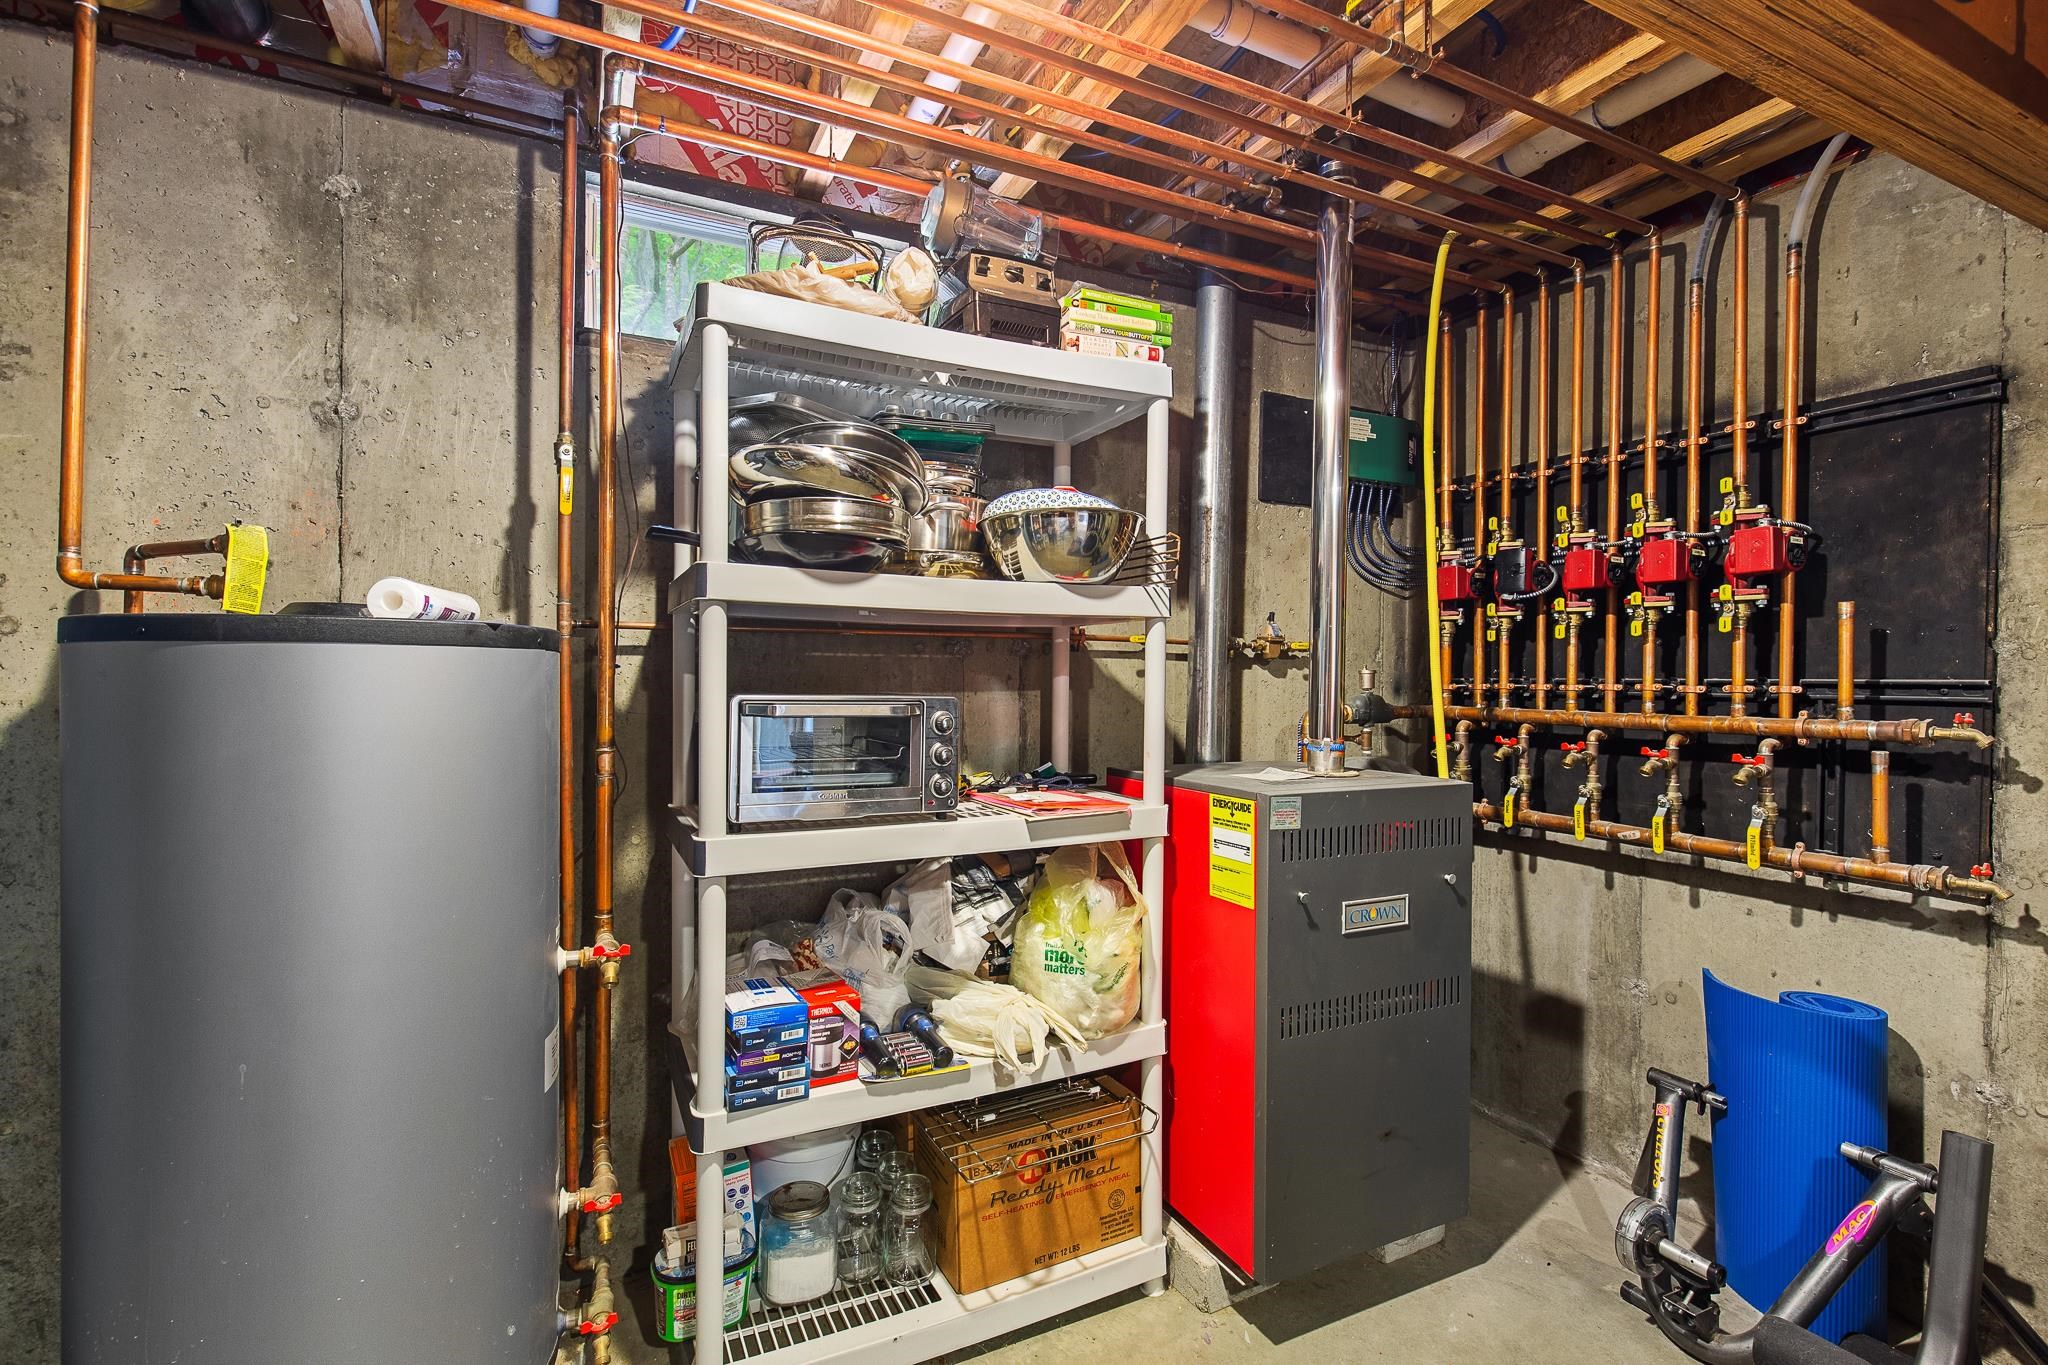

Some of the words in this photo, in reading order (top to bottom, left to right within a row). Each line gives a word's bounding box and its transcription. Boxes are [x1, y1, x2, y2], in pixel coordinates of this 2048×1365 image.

[1350, 904, 1401, 924] CROWN
[1044, 963, 1086, 976] matters
[810, 1006, 834, 1017] THERMOS
[1008, 1137, 1038, 1151] MADE
[990, 1178, 1064, 1209] Ready
[1067, 1157, 1121, 1186] Meal
[981, 1198, 1045, 1223] SELF-HEATING
[1055, 1179, 1107, 1200] EMERGENCY
[1109, 1171, 1131, 1184] MEAL
[1831, 1209, 1869, 1247] MAG
[687, 1240, 697, 1253] FEL
[1034, 1255, 1046, 1266] NET
[1047, 1250, 1059, 1261] WT:
[1060, 1248, 1068, 1257] 12
[1069, 1243, 1081, 1254] LBS
